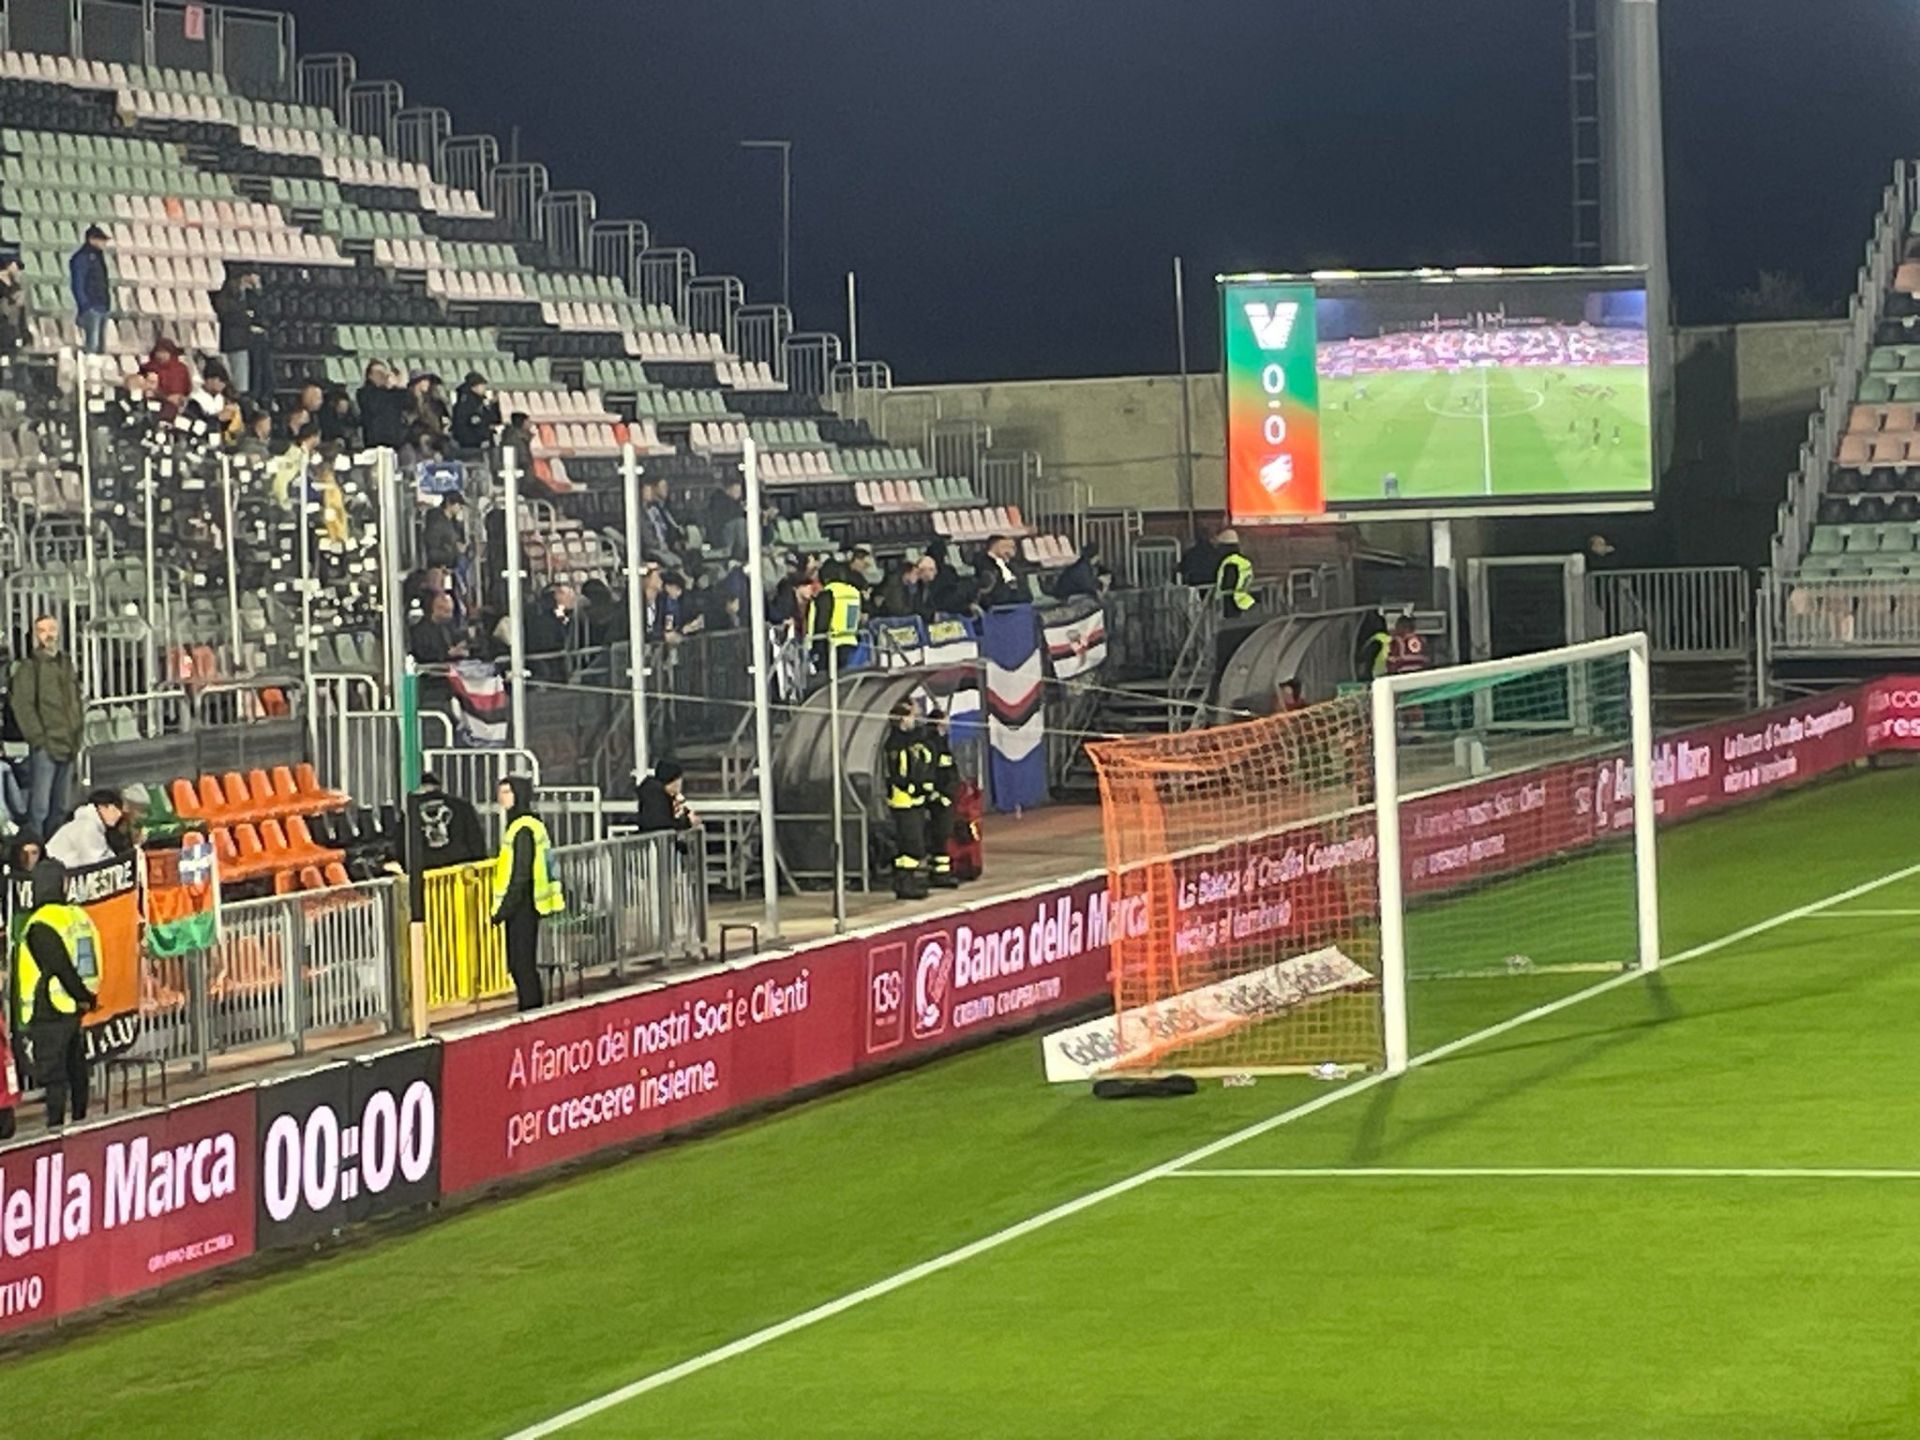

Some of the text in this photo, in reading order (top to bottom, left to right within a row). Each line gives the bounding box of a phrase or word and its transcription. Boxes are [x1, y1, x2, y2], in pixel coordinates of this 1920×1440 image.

[1262, 363, 1285, 395] 0
[1264, 414, 1287, 445] 0
[954, 888, 1150, 989] Banca della Marca
[507, 968, 810, 1089] A fianco dei nostri Soci e Clienti
[506, 1109, 545, 1158] per
[546, 1080, 634, 1137] crescere
[0, 1131, 237, 1258] ella Marca
